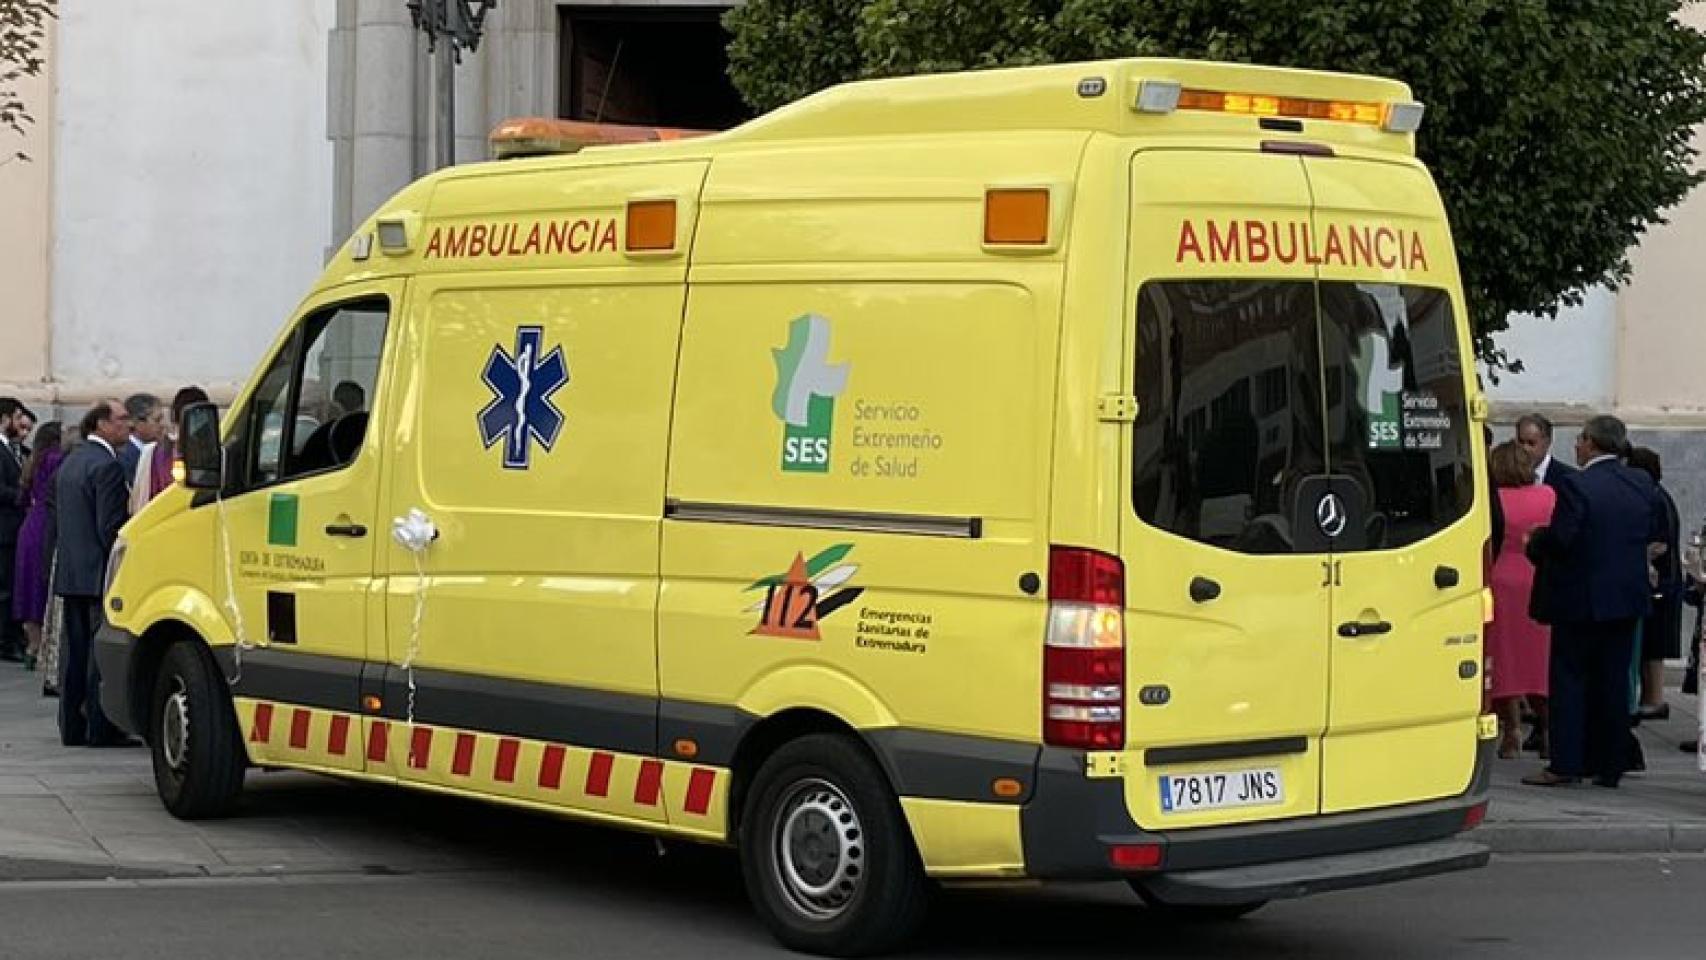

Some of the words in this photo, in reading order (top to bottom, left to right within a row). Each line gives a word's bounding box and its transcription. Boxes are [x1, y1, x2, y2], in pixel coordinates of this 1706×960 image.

[424, 218, 617, 258] AMBULANCIA
[1176, 220, 1428, 271] AMBULANCIA
[854, 400, 920, 421] Servicio
[1402, 391, 1438, 409] Servicio
[852, 427, 943, 449] Extremeño
[1370, 421, 1399, 441] SES
[785, 437, 828, 462] SES
[851, 454, 869, 477] de
[874, 455, 918, 478] Salud
[762, 583, 818, 628] 112
[860, 608, 931, 624] Emergencias
[857, 621, 910, 637] Sanitarias
[914, 627, 930, 639] de
[855, 636, 926, 653] Extremadura
[1174, 775, 1226, 807] 7817
[1238, 771, 1278, 801] JNS
